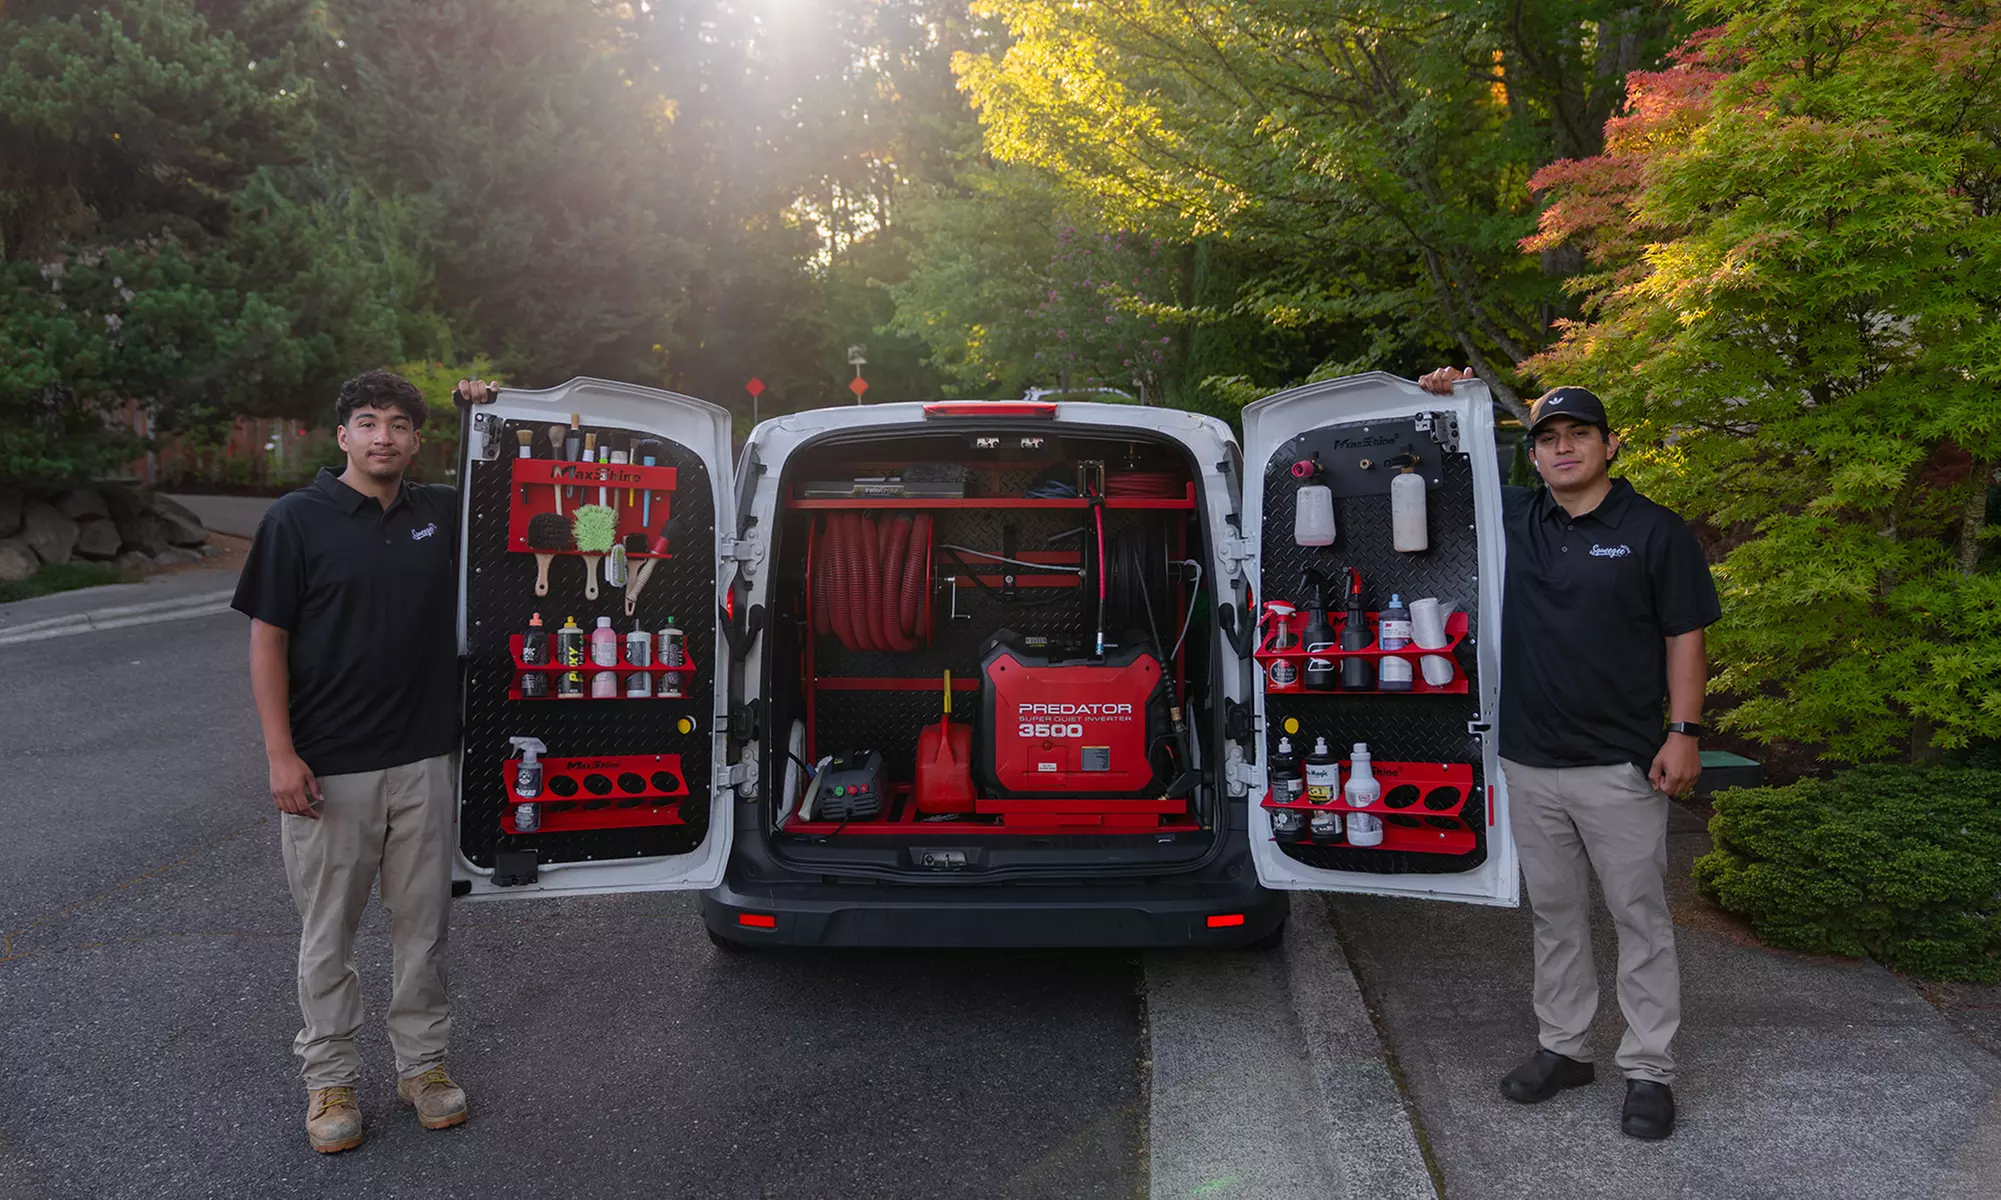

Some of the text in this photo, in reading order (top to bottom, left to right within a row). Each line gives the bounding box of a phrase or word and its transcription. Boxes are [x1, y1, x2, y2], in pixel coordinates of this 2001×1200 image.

[551, 464, 641, 482] MaxShine
[1019, 703, 1132, 714] PREDATOR
[1018, 724, 1083, 737] 3500
